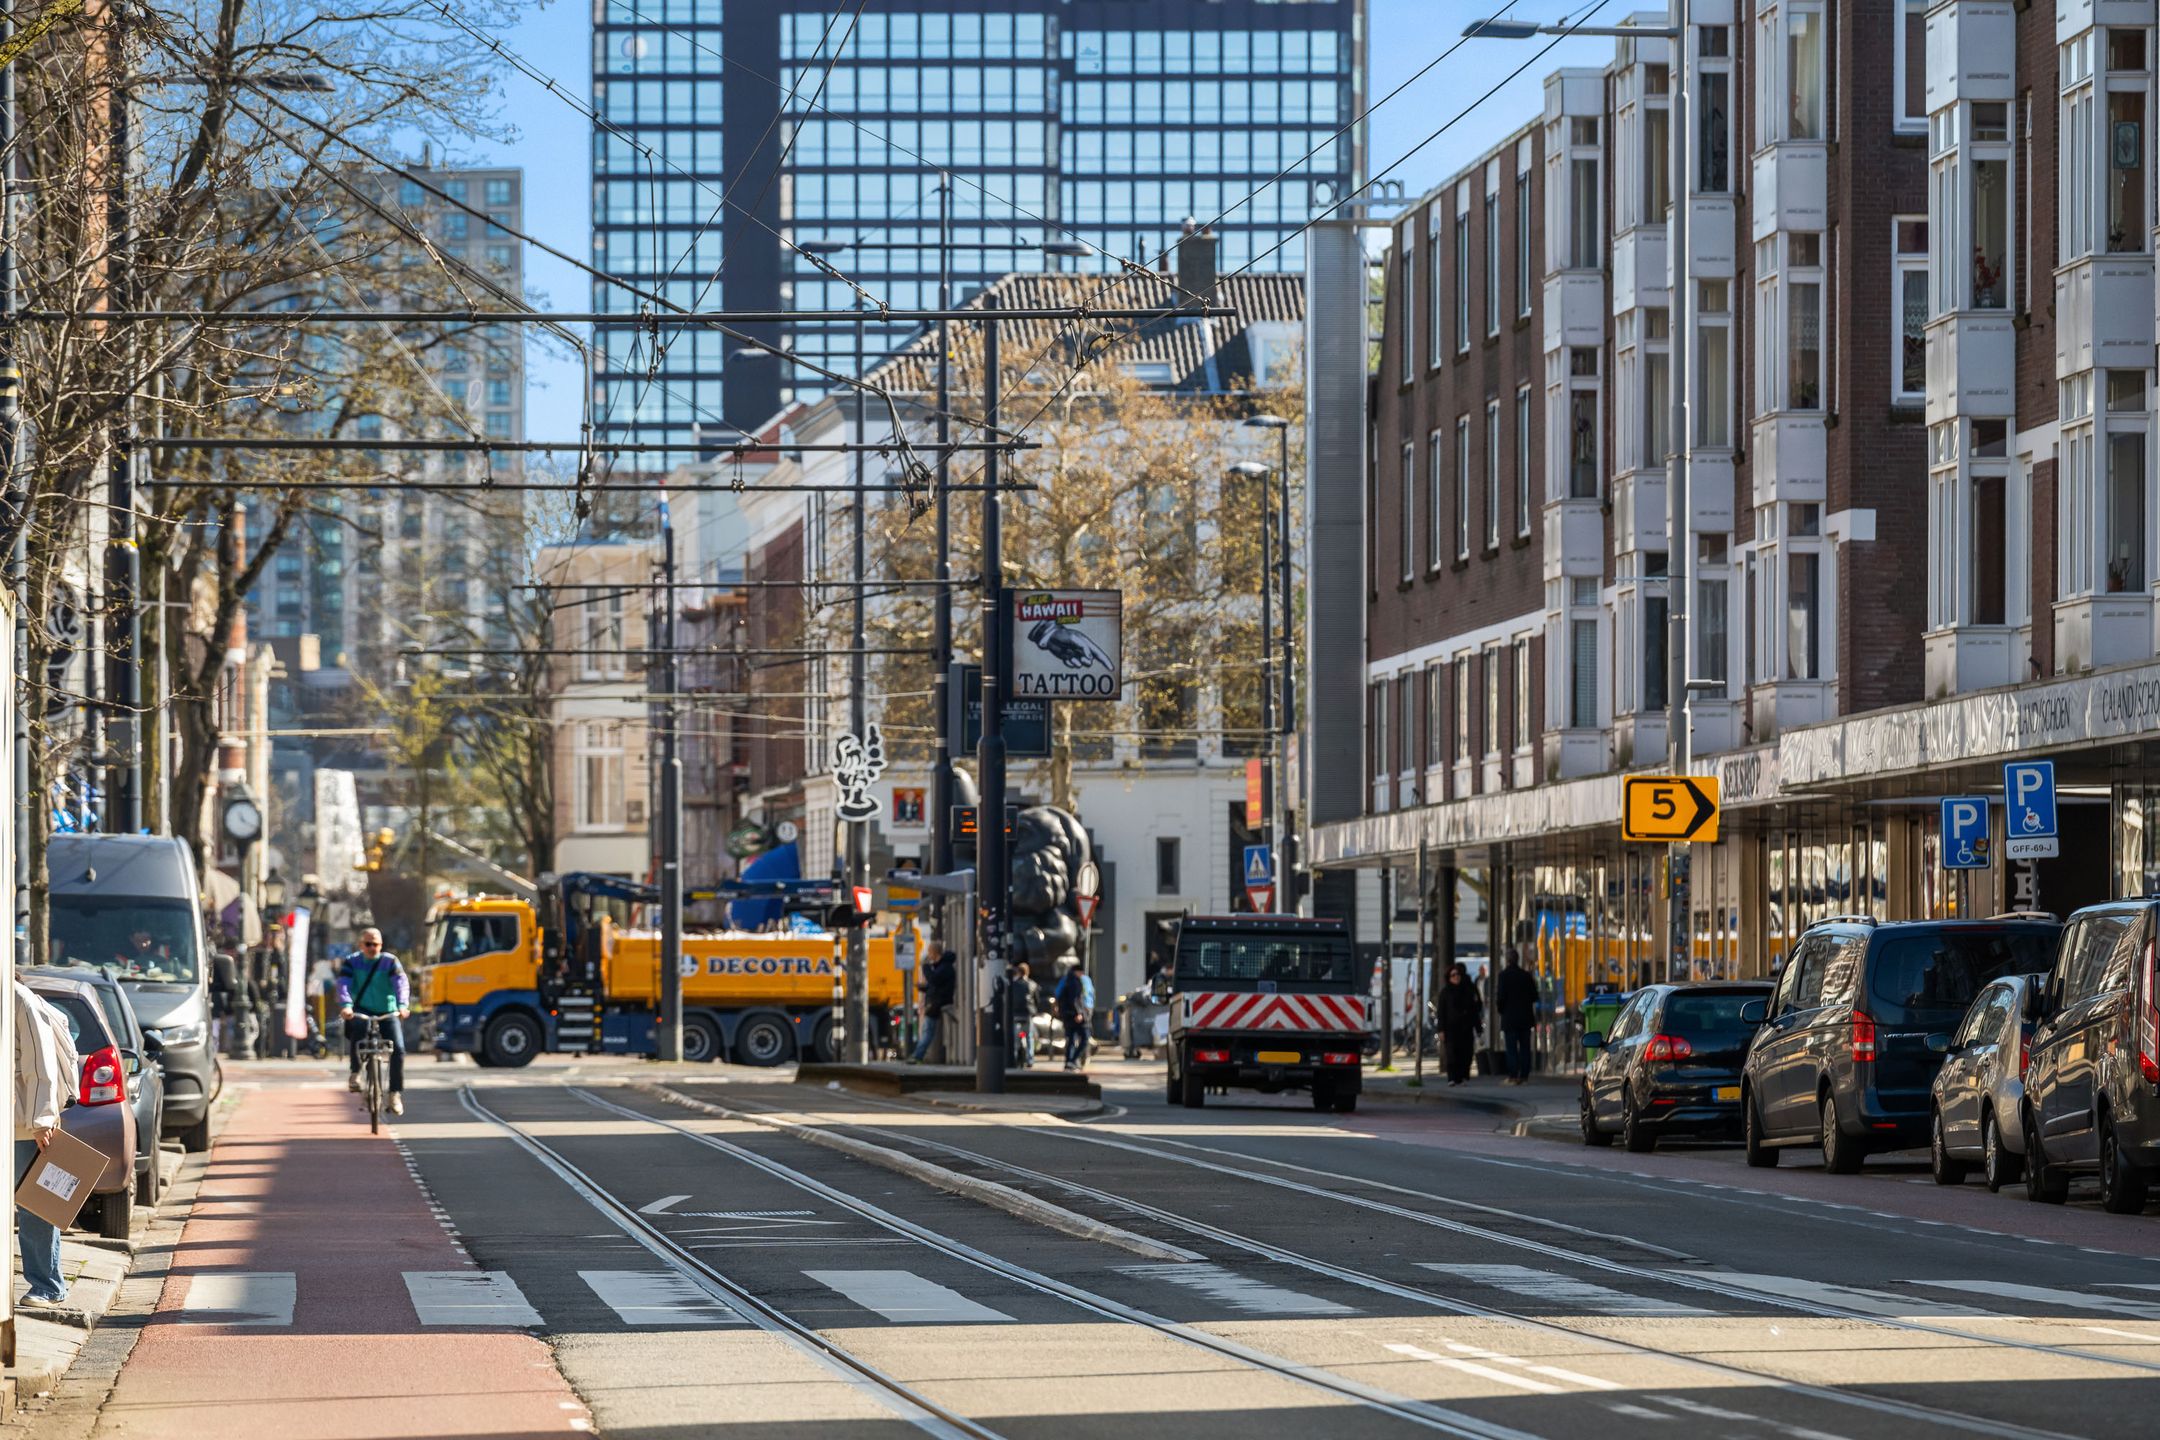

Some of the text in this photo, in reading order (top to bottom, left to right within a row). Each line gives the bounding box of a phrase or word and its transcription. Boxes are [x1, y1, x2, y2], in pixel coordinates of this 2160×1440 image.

[1022, 602, 1077, 619] HAWAII
[1018, 673, 1114, 695] TATTOO
[2011, 697, 2071, 736] LAND/SCHOEN
[1723, 756, 1761, 799] SEXSHOP
[2016, 768, 2043, 806] P
[1652, 789, 1676, 820] 5
[1953, 803, 1978, 839] P
[2012, 844, 2052, 853] GFF-69-J
[708, 957, 848, 974] DECOTRA
